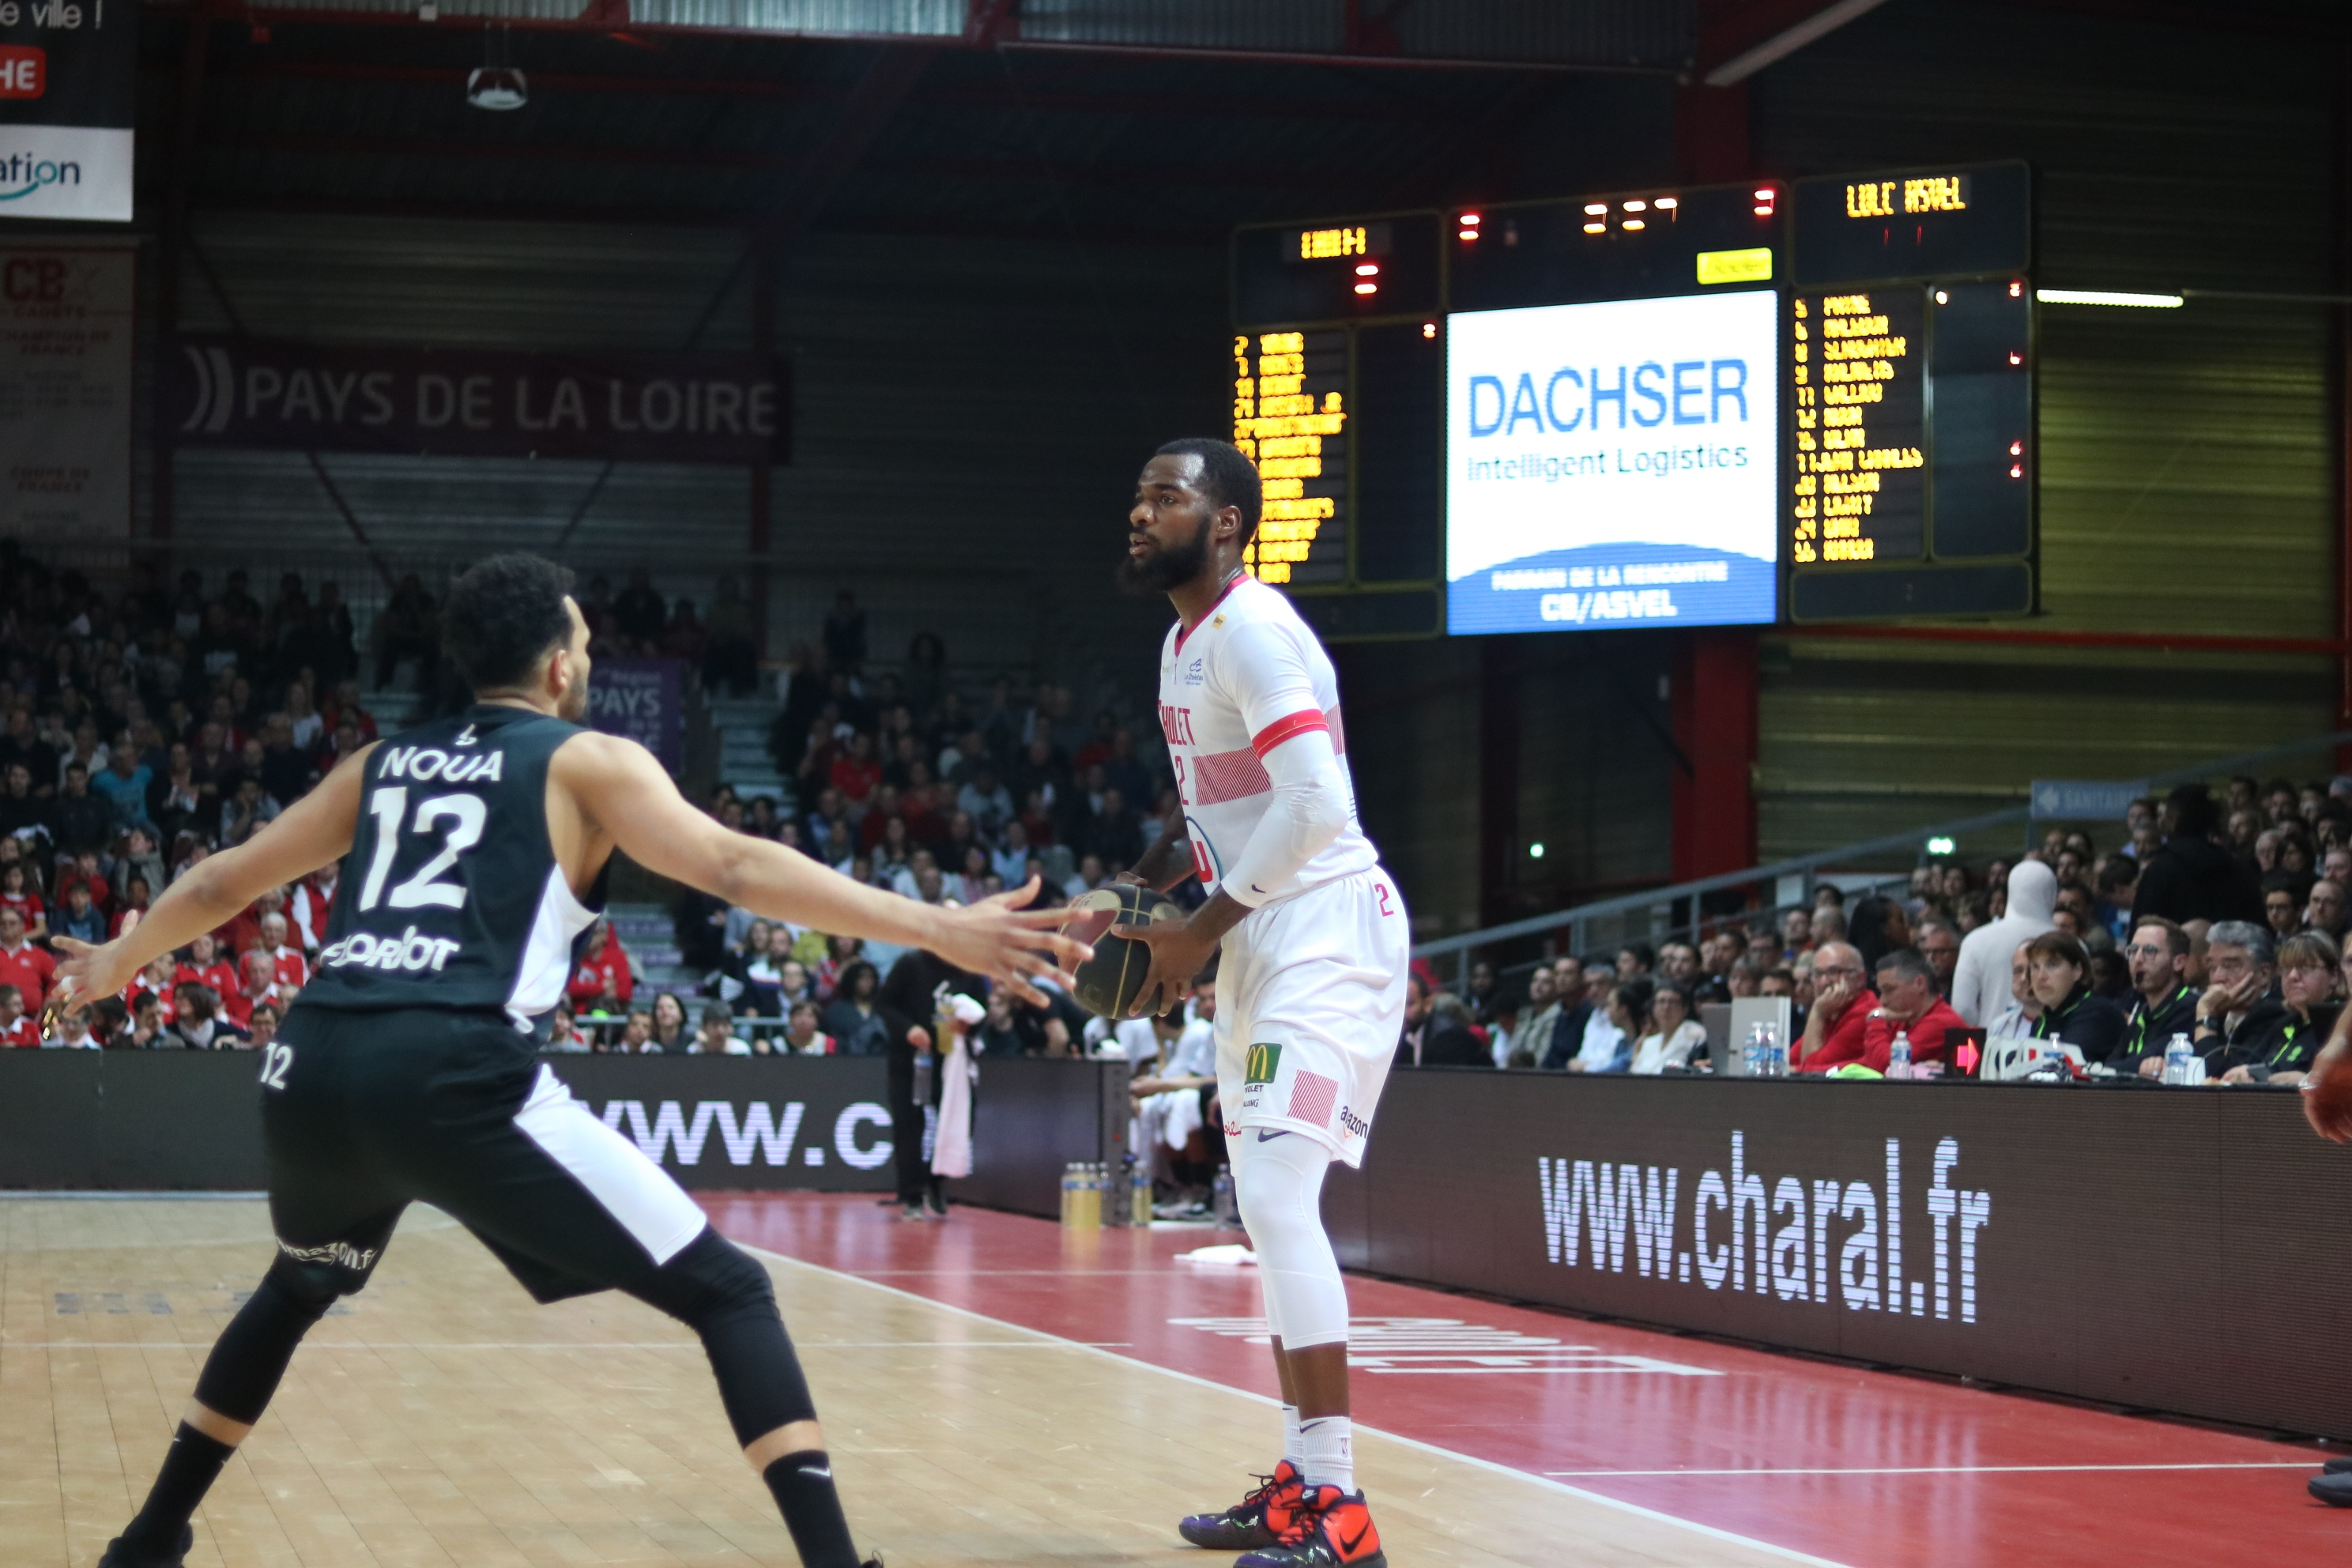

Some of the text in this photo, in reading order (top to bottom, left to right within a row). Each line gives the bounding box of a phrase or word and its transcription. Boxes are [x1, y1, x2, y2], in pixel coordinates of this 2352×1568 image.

[245, 367, 775, 436] PAYS DE LA LOIRE
[1468, 358, 1748, 438] DACHSER
[1468, 444, 1747, 484] Intelligent Logistics
[1569, 566, 1595, 588] DE
[1596, 565, 1622, 586] LA
[1540, 589, 1677, 624] CB/ASVEL
[589, 685, 662, 725] PAYS
[379, 745, 505, 782] NOUA
[1174, 756, 1189, 806] 2
[358, 786, 488, 913] 12
[1374, 883, 1395, 917] 2
[260, 1042, 293, 1091] 12
[1539, 1129, 1991, 1324] www.charal.fr
